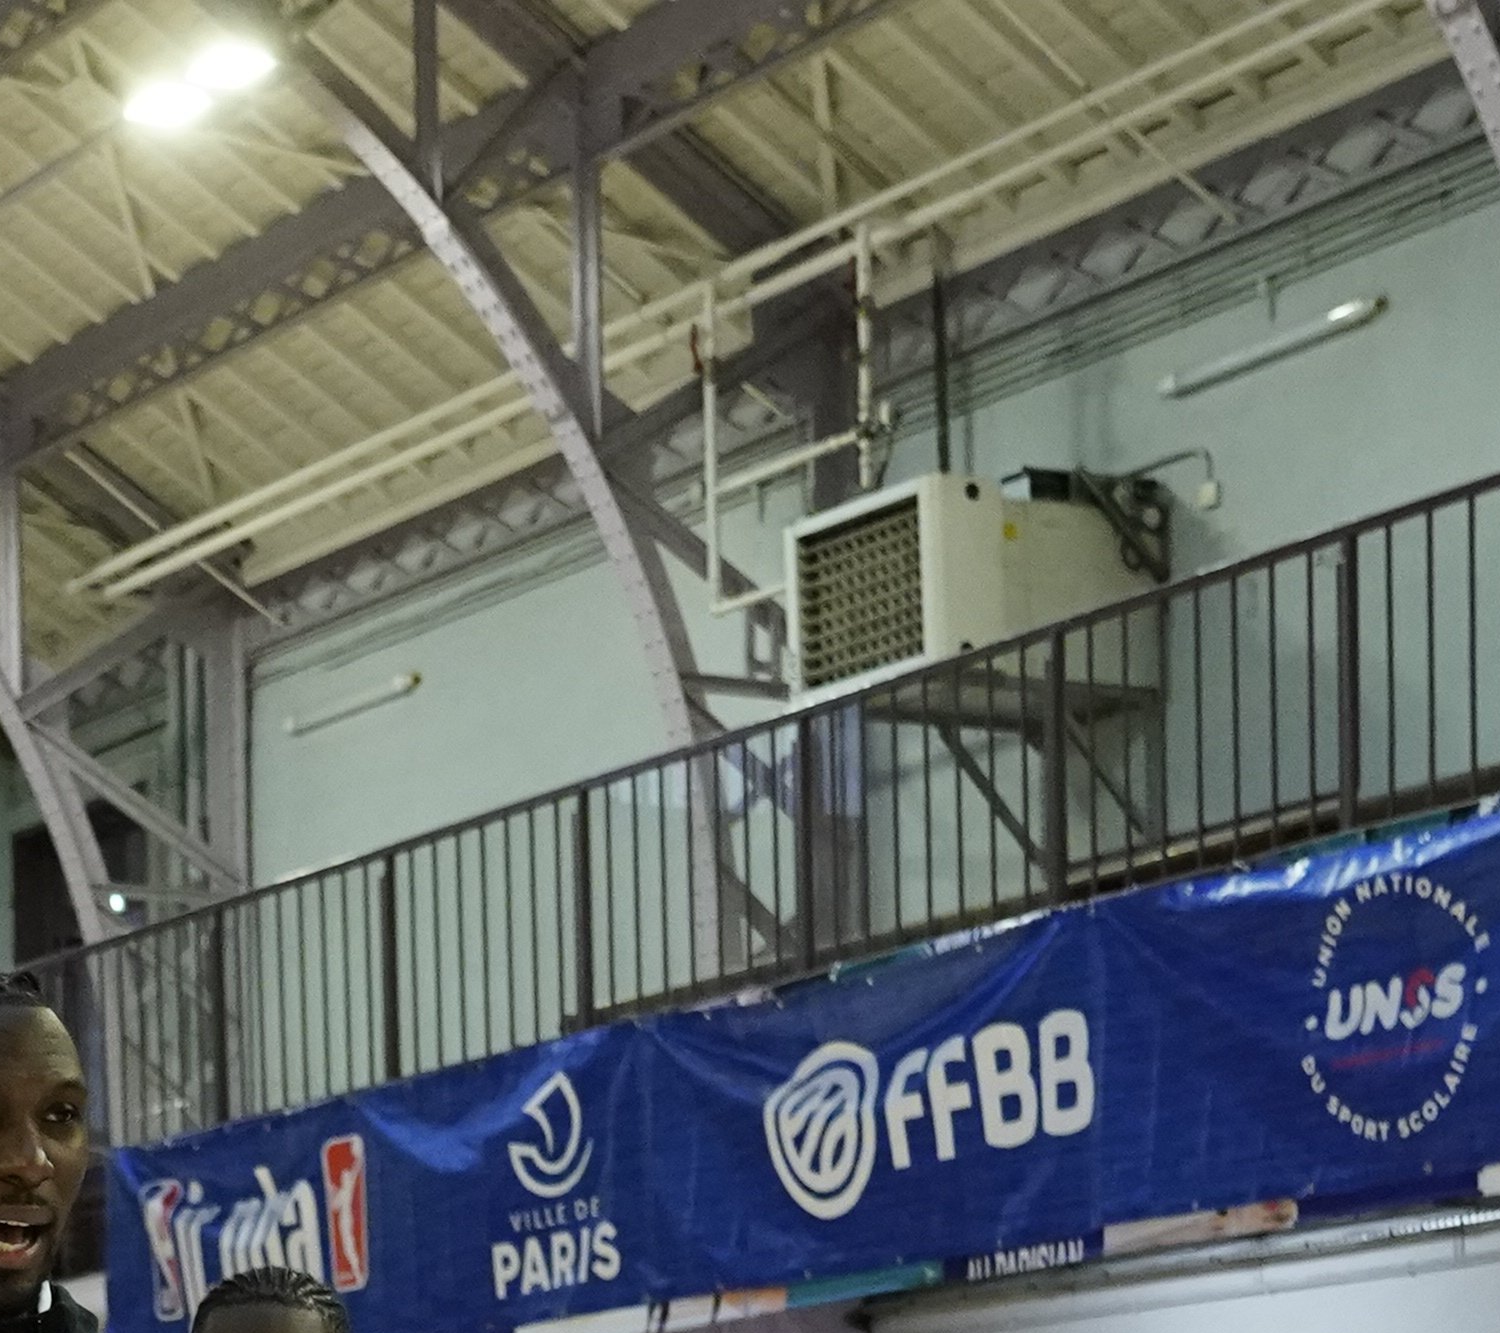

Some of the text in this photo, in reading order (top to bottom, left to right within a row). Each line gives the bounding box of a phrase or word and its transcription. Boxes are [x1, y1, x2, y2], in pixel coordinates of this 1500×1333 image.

[1312, 873, 1490, 988] UNION NATIONALE
[885, 1009, 1094, 1170] FFBB
[1301, 1022, 1478, 1141] DU SPORT SCOLAIRE
[492, 1220, 621, 1300] PARIS
[509, 1196, 601, 1232] VILLE DE
